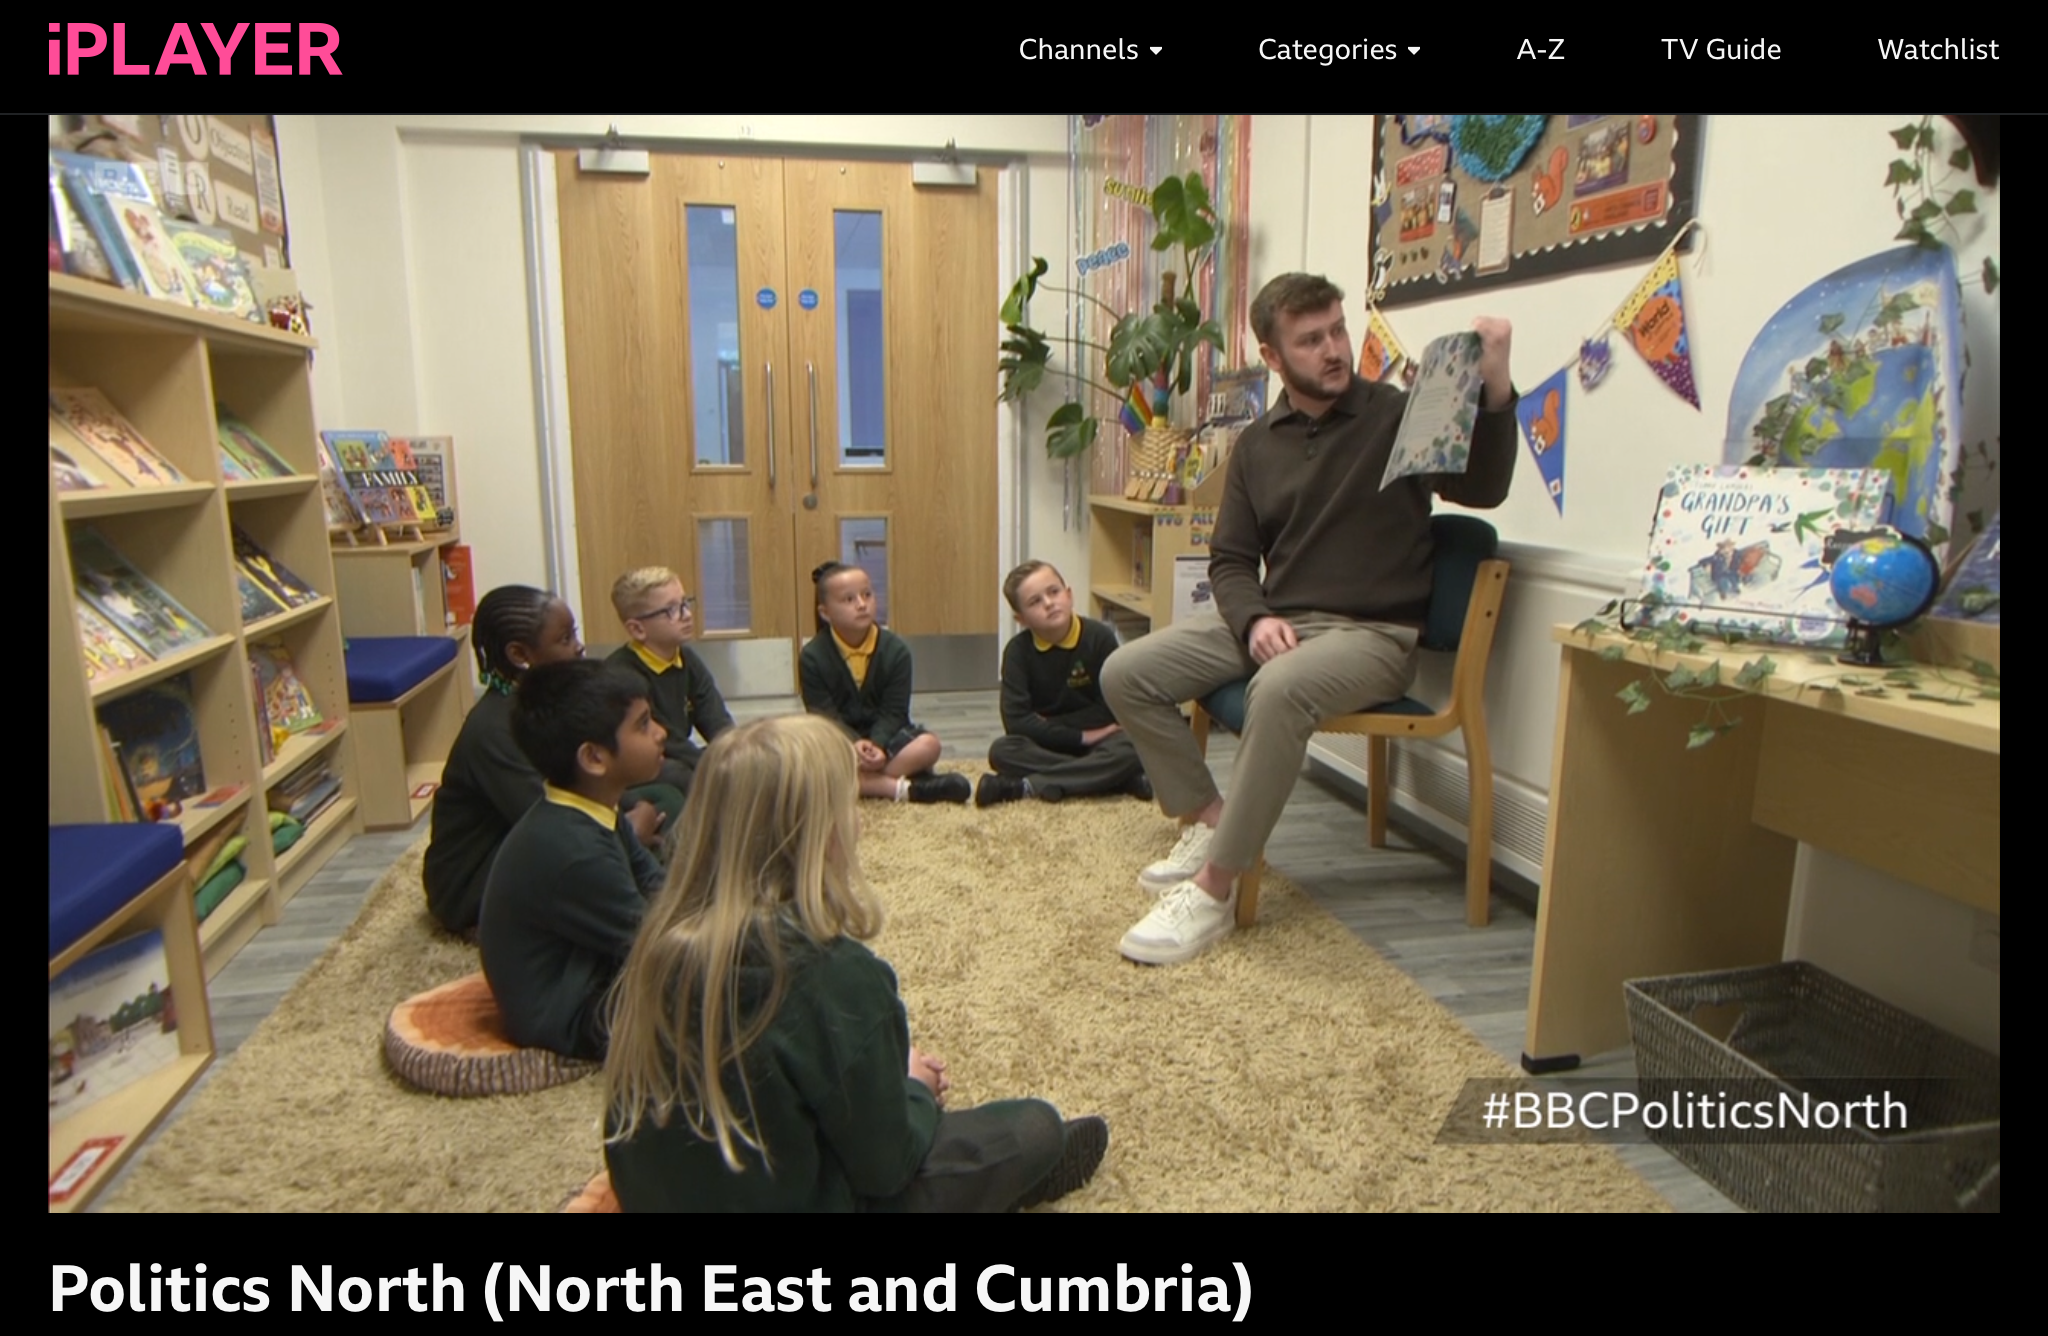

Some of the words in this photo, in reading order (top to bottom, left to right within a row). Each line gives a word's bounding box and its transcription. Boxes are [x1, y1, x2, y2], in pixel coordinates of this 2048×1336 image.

[1638, 300, 1670, 337] World
[361, 471, 419, 488] FAMILY
[1680, 490, 1790, 515] GRANDPA'S
[1700, 514, 1753, 539] GIFT
